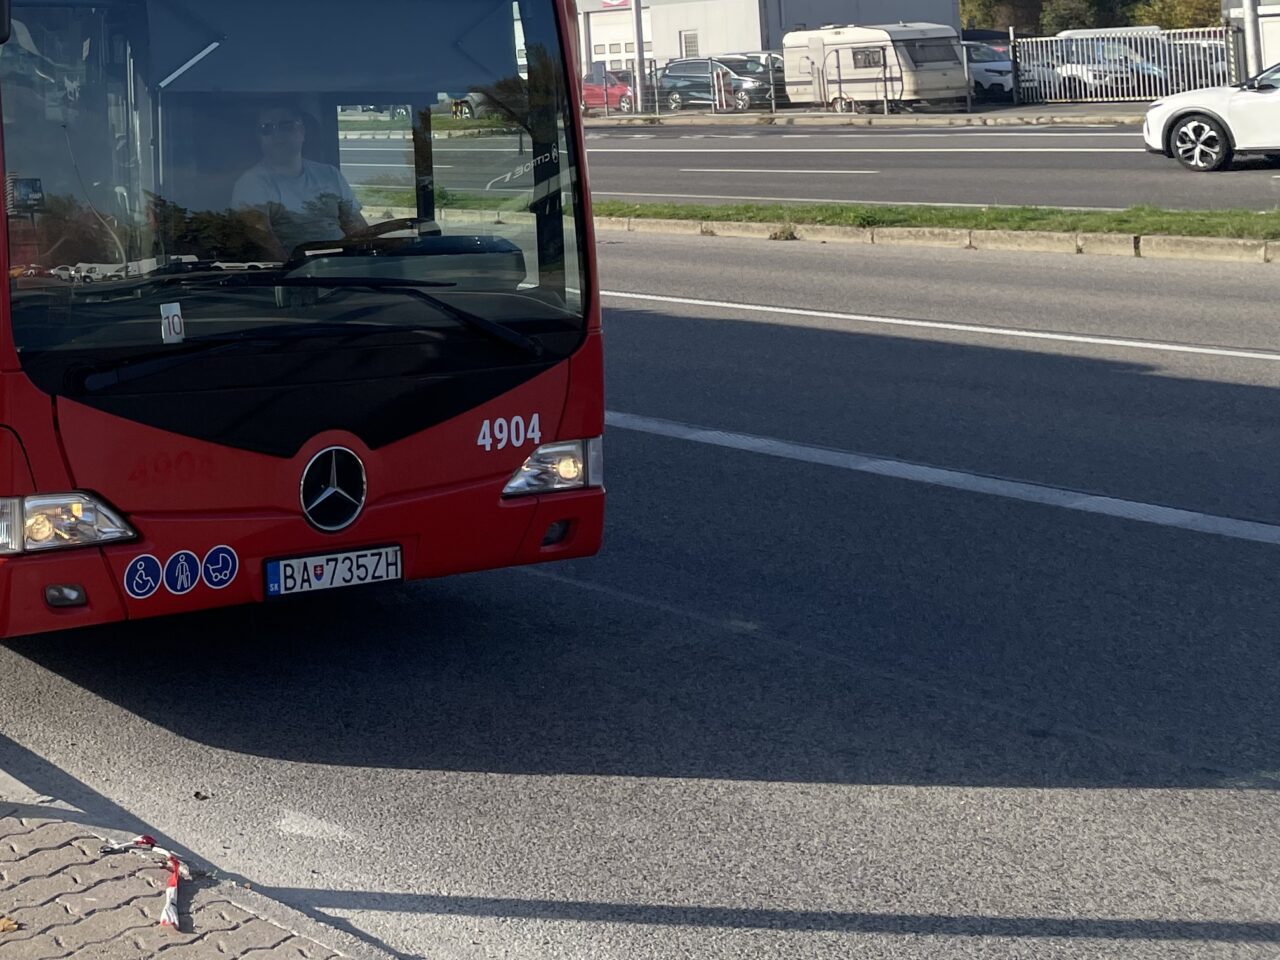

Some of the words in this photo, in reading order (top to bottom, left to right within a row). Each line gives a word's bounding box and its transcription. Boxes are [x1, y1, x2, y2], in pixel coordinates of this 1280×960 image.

[163, 313, 183, 337] 10
[476, 413, 542, 452] 4904
[269, 583, 280, 592] SK
[283, 561, 313, 592] BA
[325, 550, 399, 586] 735ZH
